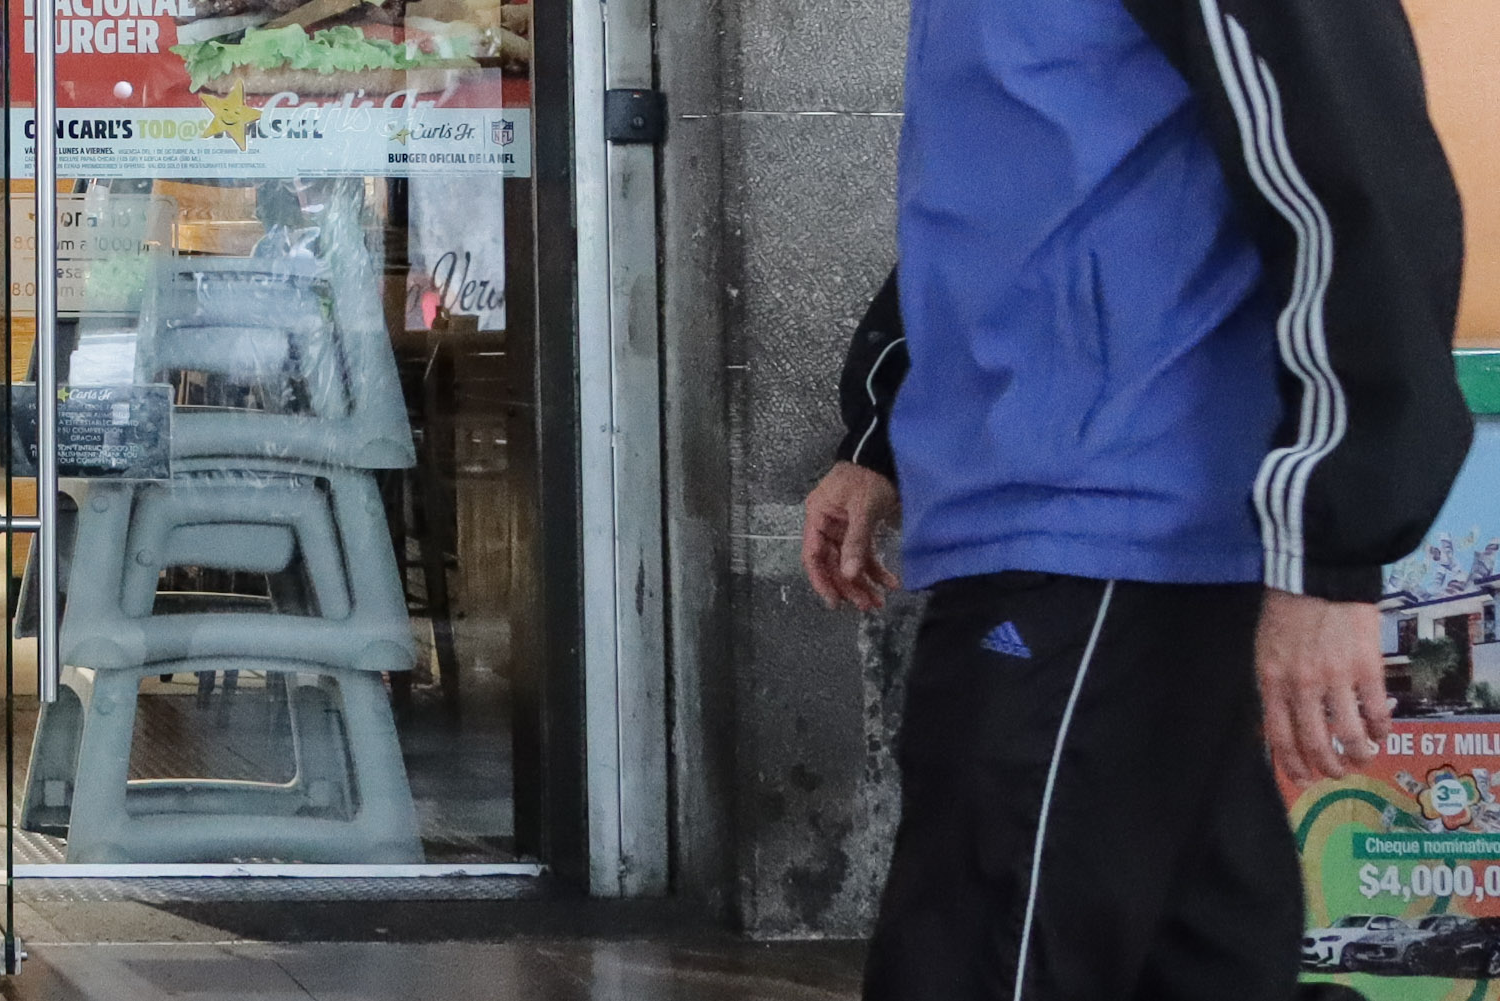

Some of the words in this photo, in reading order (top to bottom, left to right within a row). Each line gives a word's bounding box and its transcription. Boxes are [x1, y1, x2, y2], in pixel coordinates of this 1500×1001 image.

[68, 119, 133, 139] CARL'S
[410, 122, 451, 140] Carl's
[453, 122, 475, 141] Jr.
[58, 147, 79, 155] LUNES
[388, 153, 428, 164] BURGER
[429, 153, 466, 164] OFICIAL
[468, 153, 482, 164] DE
[483, 153, 495, 164] LA
[496, 153, 515, 164] NFL
[70, 434, 101, 442] GRACIAS
[1386, 733, 1414, 755] DE
[1421, 733, 1447, 755] 67
[1365, 837, 1420, 856] Cheque
[1423, 837, 1500, 854] nominativo
